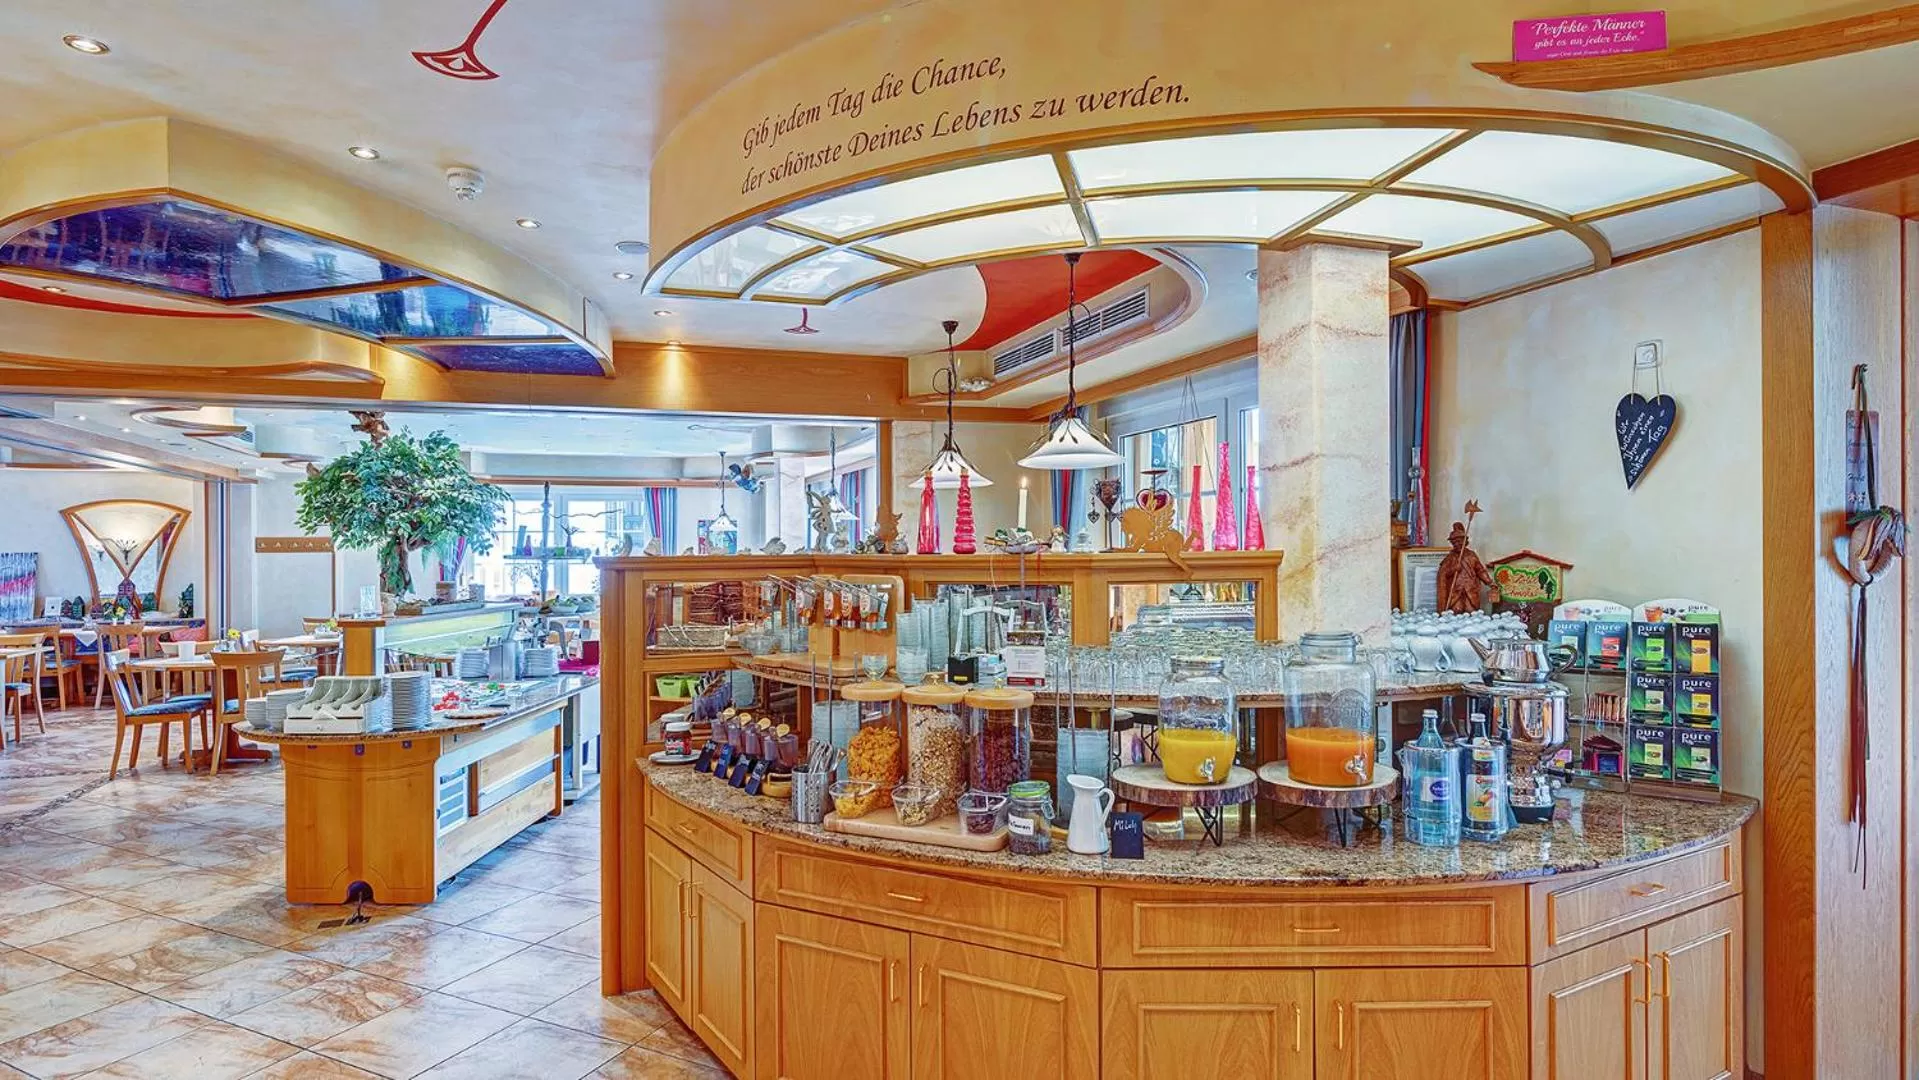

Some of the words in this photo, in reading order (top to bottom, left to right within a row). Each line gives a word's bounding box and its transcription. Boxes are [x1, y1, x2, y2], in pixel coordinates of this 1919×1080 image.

[1592, 17, 1646, 32] Männer
[1533, 37, 1553, 50] gibt
[1556, 39, 1567, 47] es
[1570, 38, 1583, 46] an
[1582, 33, 1610, 48] jeder
[743, 116, 770, 159] Gib
[768, 102, 821, 148] jedem
[827, 87, 866, 118] Tag
[871, 72, 904, 104] die
[911, 56, 1006, 96] Chance,
[741, 166, 765, 195] der
[767, 143, 842, 184] schönste
[847, 122, 925, 157] Deines
[931, 101, 1023, 138] Lebens
[1029, 96, 1065, 120] zu
[1075, 75, 1190, 113] werden.
[1648, 425, 1668, 443] Tag
[1554, 621, 1581, 633] pure
[1594, 623, 1622, 634] pure
[1637, 624, 1666, 636] pure
[1682, 626, 1711, 638] pure
[1637, 676, 1665, 686] pure
[1682, 680, 1712, 690] pure
[1635, 728, 1665, 739] pure
[1681, 732, 1712, 743] pure
